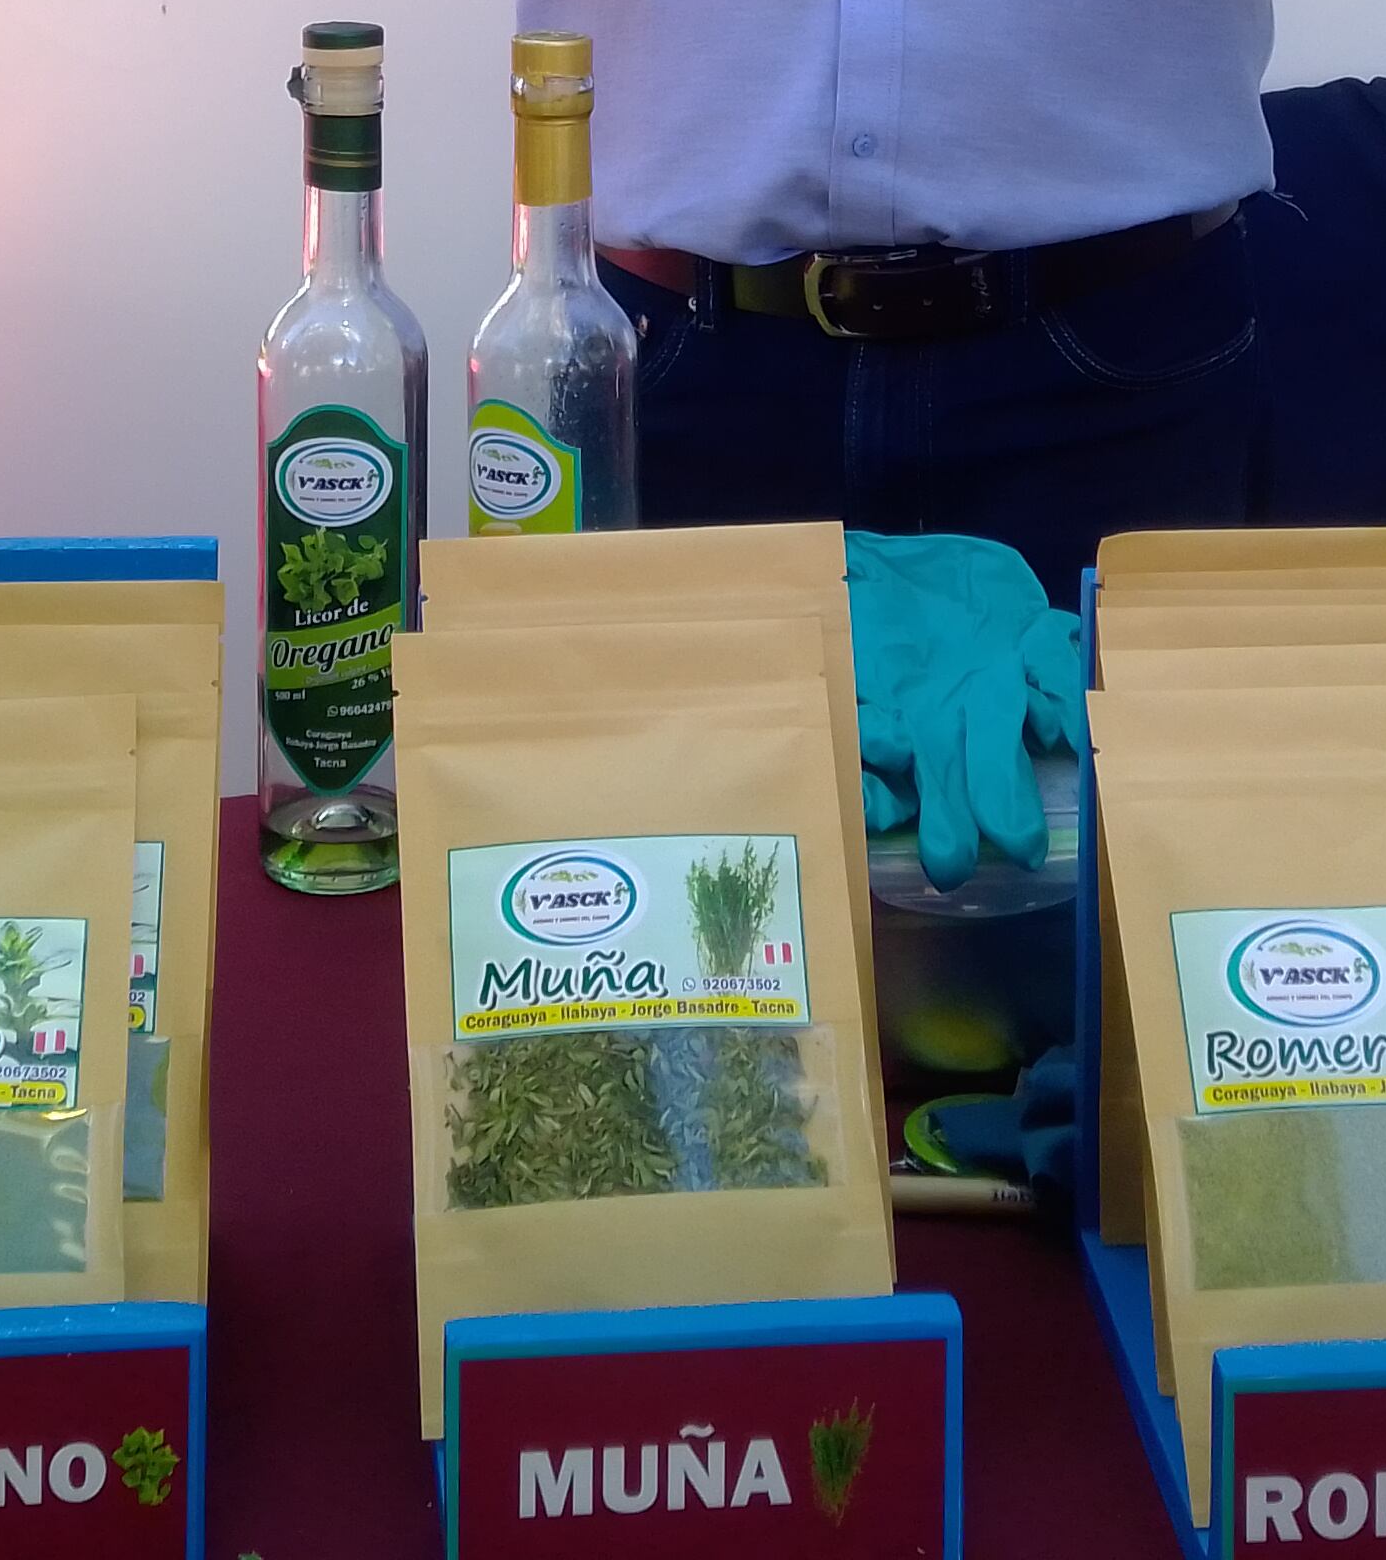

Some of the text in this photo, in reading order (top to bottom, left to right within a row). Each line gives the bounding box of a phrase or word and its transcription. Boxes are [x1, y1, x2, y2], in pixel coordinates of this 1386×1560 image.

[295, 598, 370, 627] Licor de
[270, 623, 395, 675] Oregano
[314, 756, 347, 768] Tacna
[479, 950, 668, 1010] Muña
[702, 978, 781, 991] 920673502
[465, 999, 795, 1030] Coraguaya Ilabaya Jorge Basadre Tacna
[10, 1084, 57, 1100] Tacna
[1212, 1085, 1297, 1104] Coraguaya
[1310, 1081, 1366, 1098] Ilabaya
[518, 1423, 793, 1520] MUÑA
